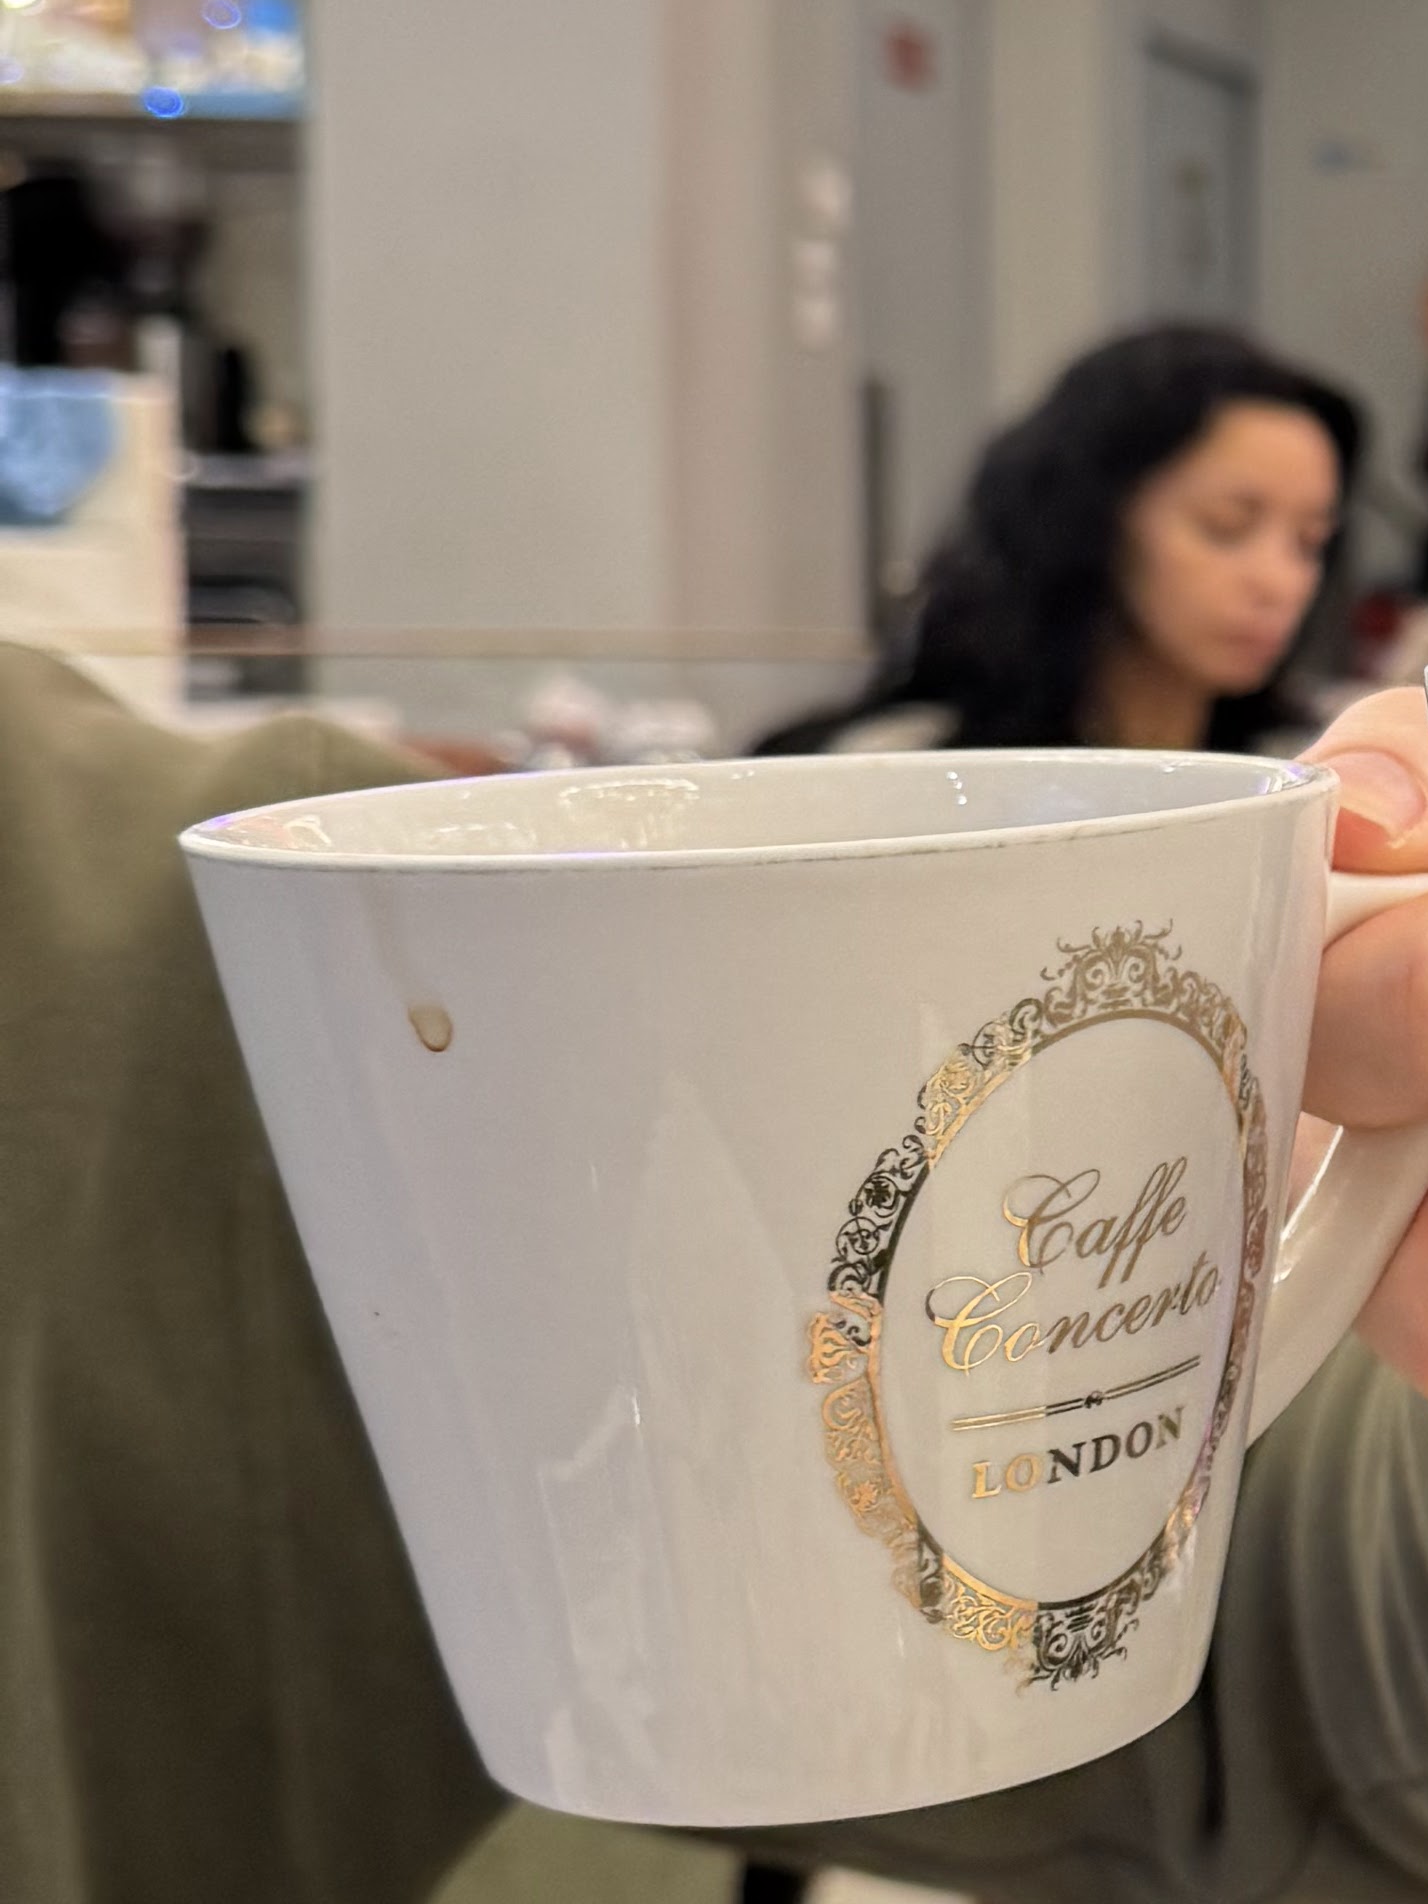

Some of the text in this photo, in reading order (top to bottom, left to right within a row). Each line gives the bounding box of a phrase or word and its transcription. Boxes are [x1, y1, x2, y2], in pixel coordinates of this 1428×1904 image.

[1003, 1156, 1187, 1286] Caffe
[925, 1250, 1219, 1376] Concerto
[971, 1403, 1184, 1500] LONDON
